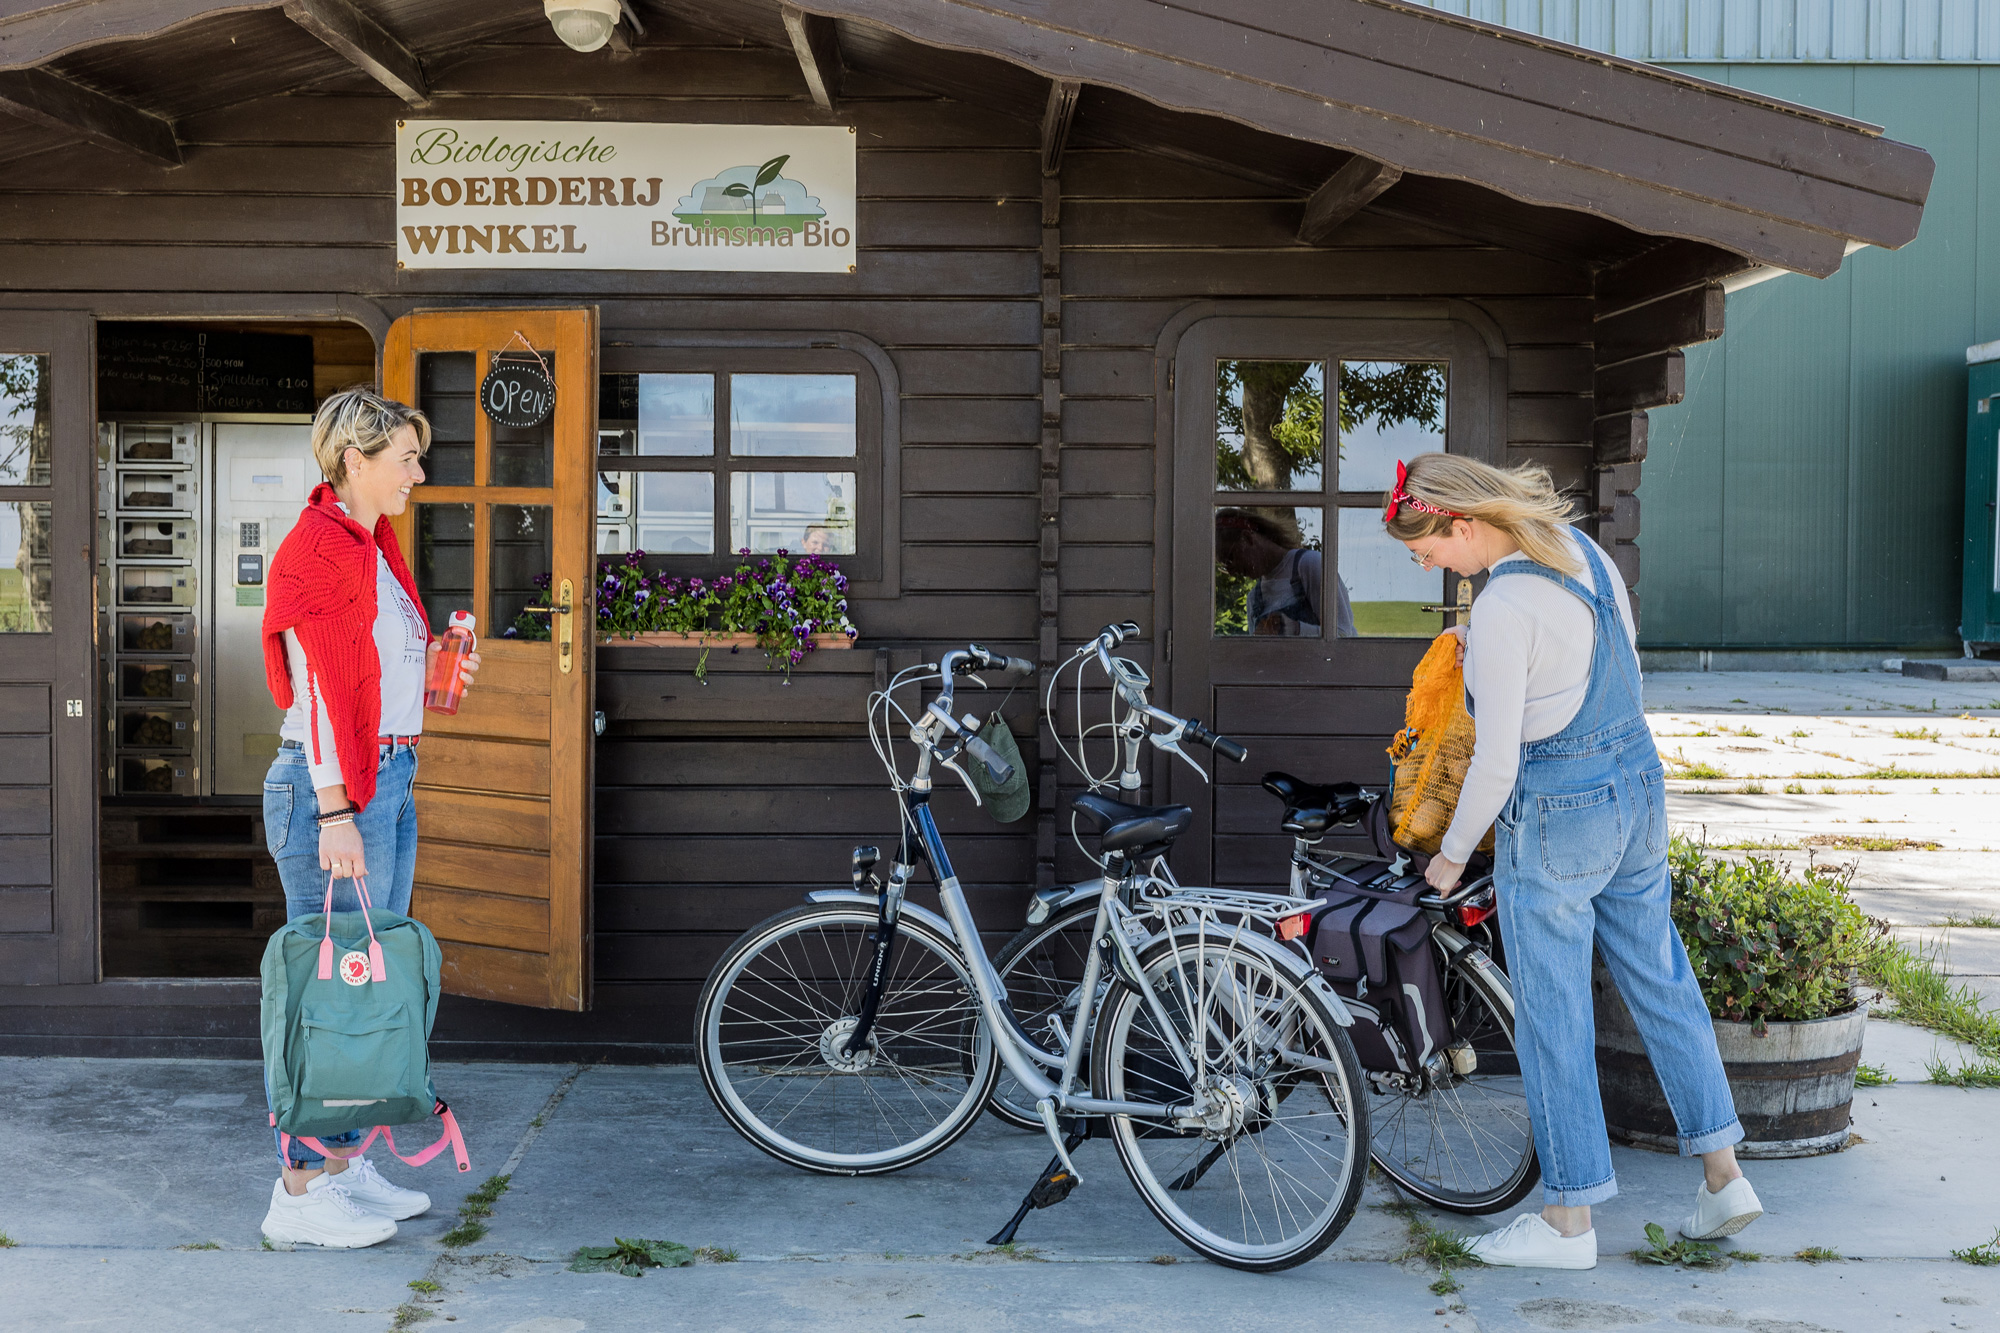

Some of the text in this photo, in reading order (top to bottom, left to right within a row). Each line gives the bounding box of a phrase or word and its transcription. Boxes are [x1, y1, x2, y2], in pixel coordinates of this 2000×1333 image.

[410, 127, 617, 172] Biologische
[401, 177, 663, 207] BOERDERIJ
[401, 224, 587, 254] WINKEL
[650, 219, 851, 248] Bruinsma Bio
[402, 655, 412, 664] 77
[872, 950, 884, 987] UNION
